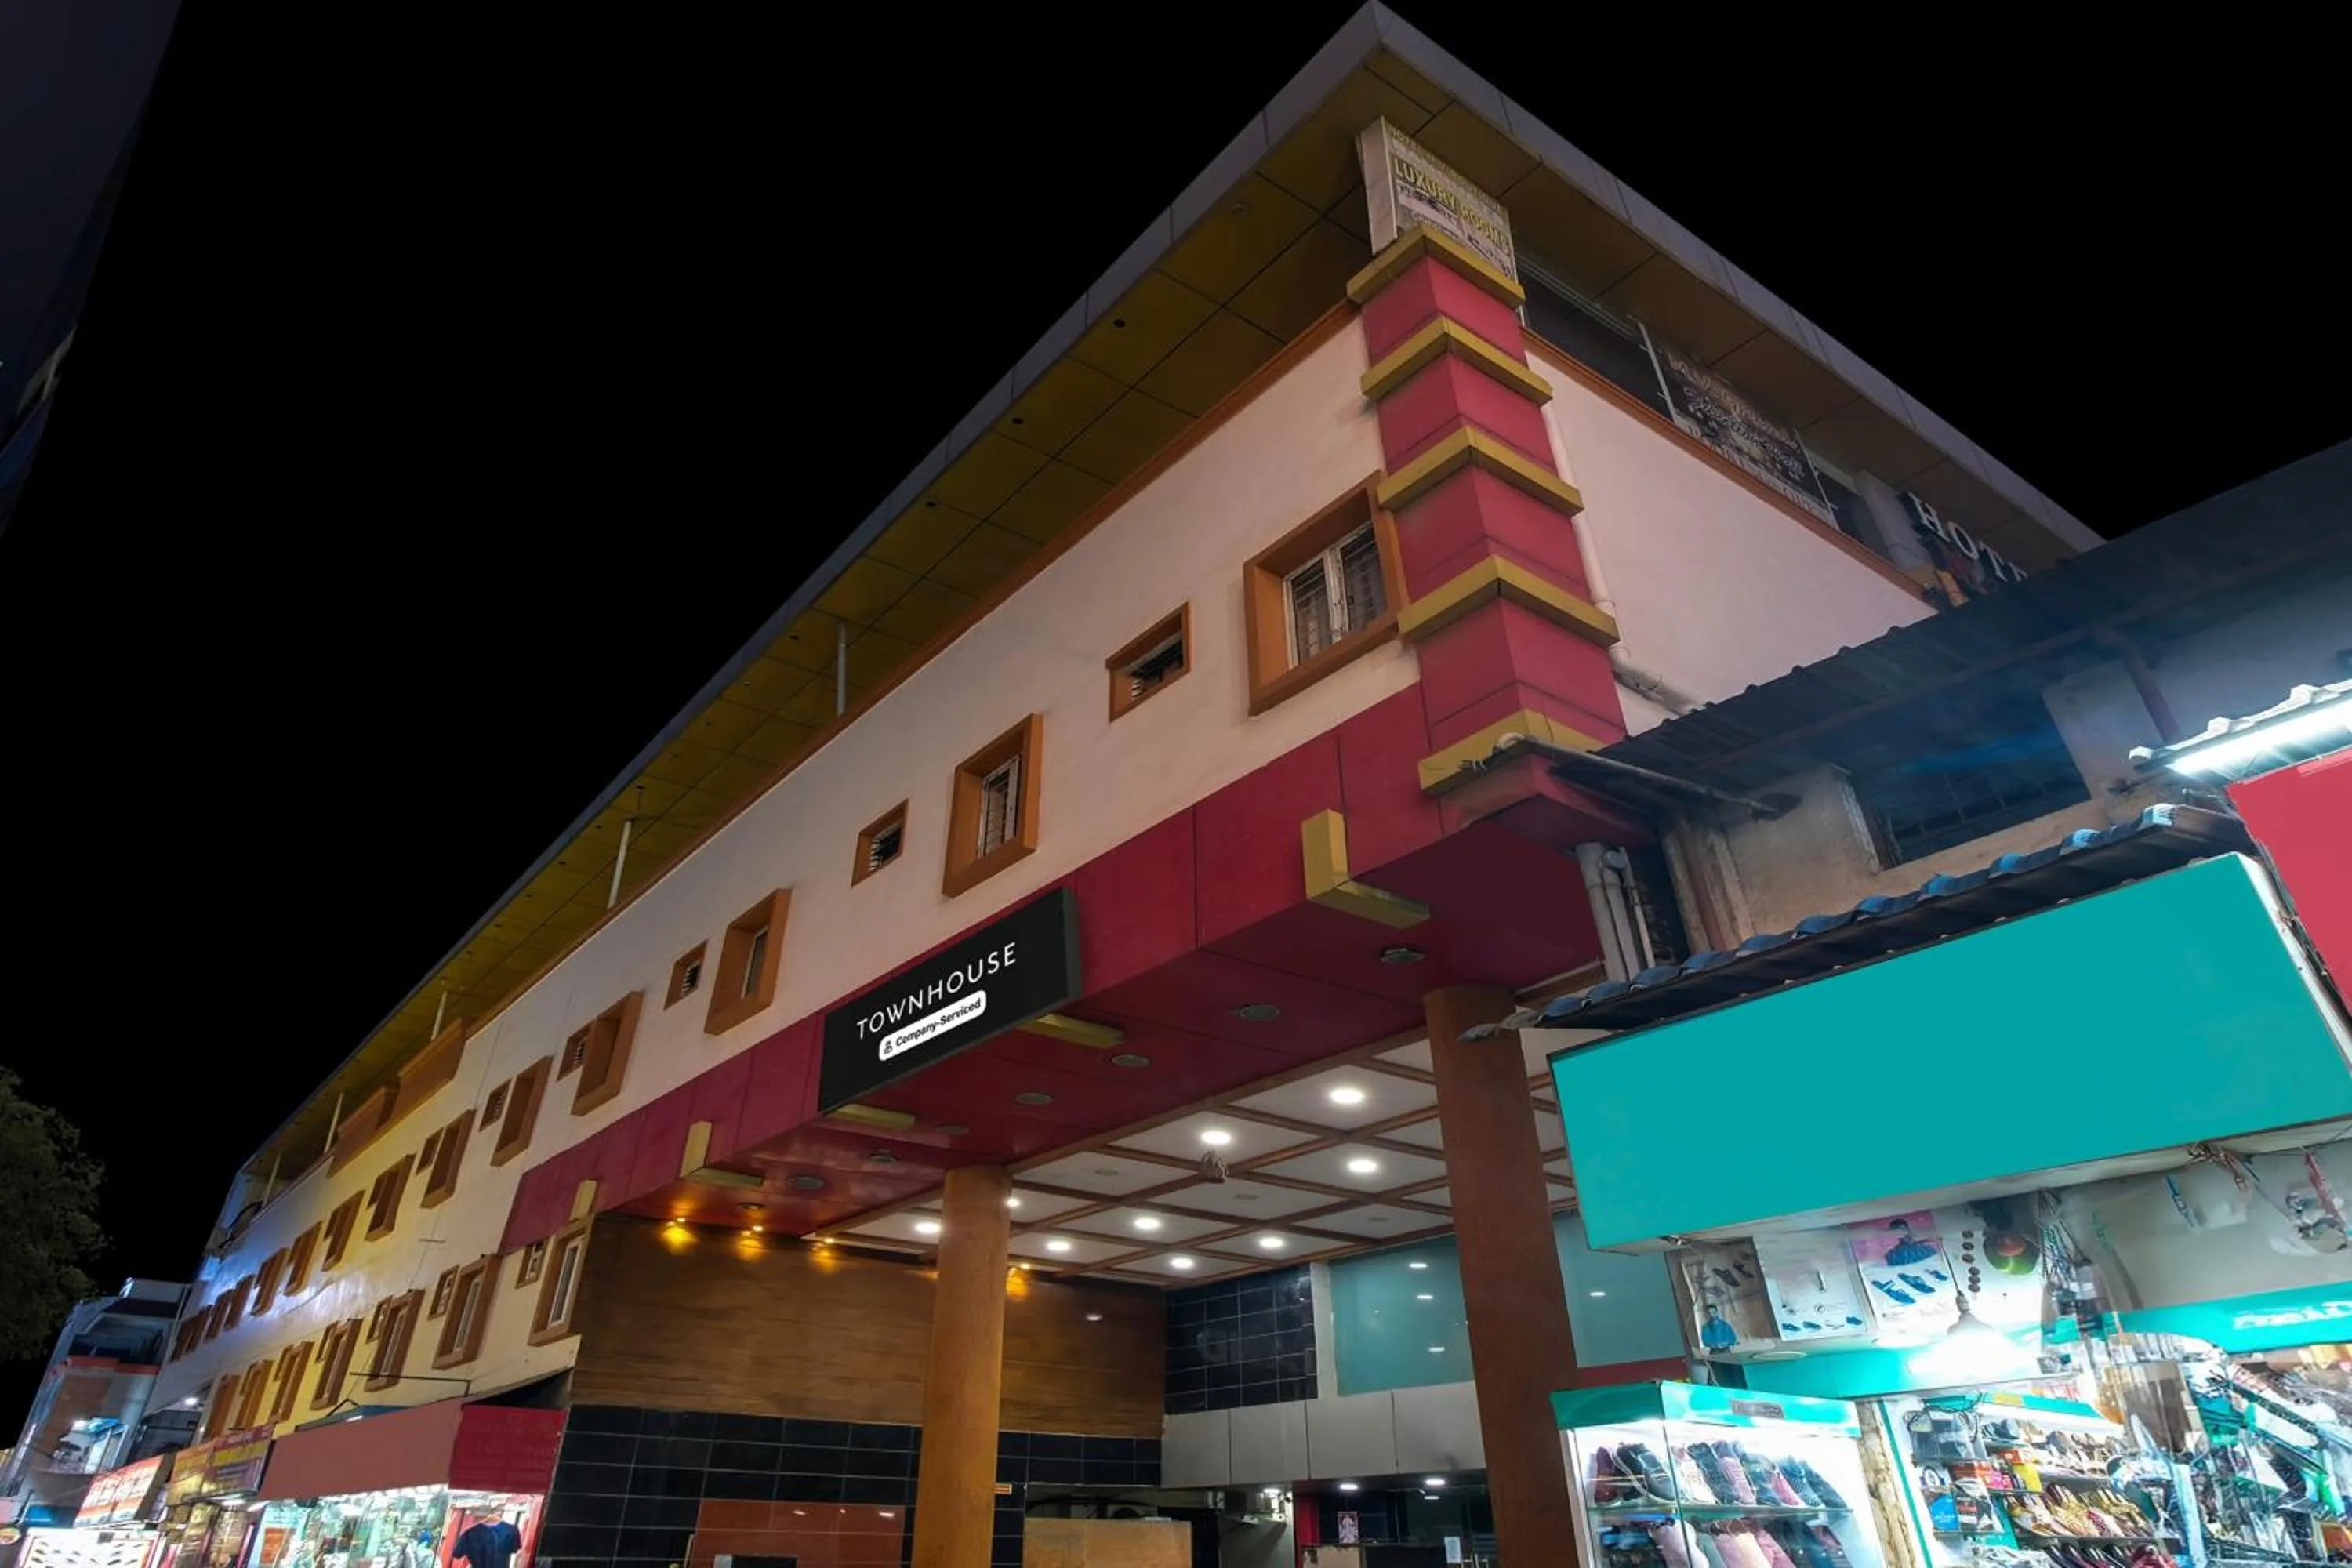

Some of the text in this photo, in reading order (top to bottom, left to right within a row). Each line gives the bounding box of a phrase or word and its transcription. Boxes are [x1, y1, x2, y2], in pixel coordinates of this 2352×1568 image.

[1394, 158, 1457, 212] LUXURY
[856, 941, 1018, 1040] TOWNHOUSE
[895, 996, 982, 1047] Company-Serviced
